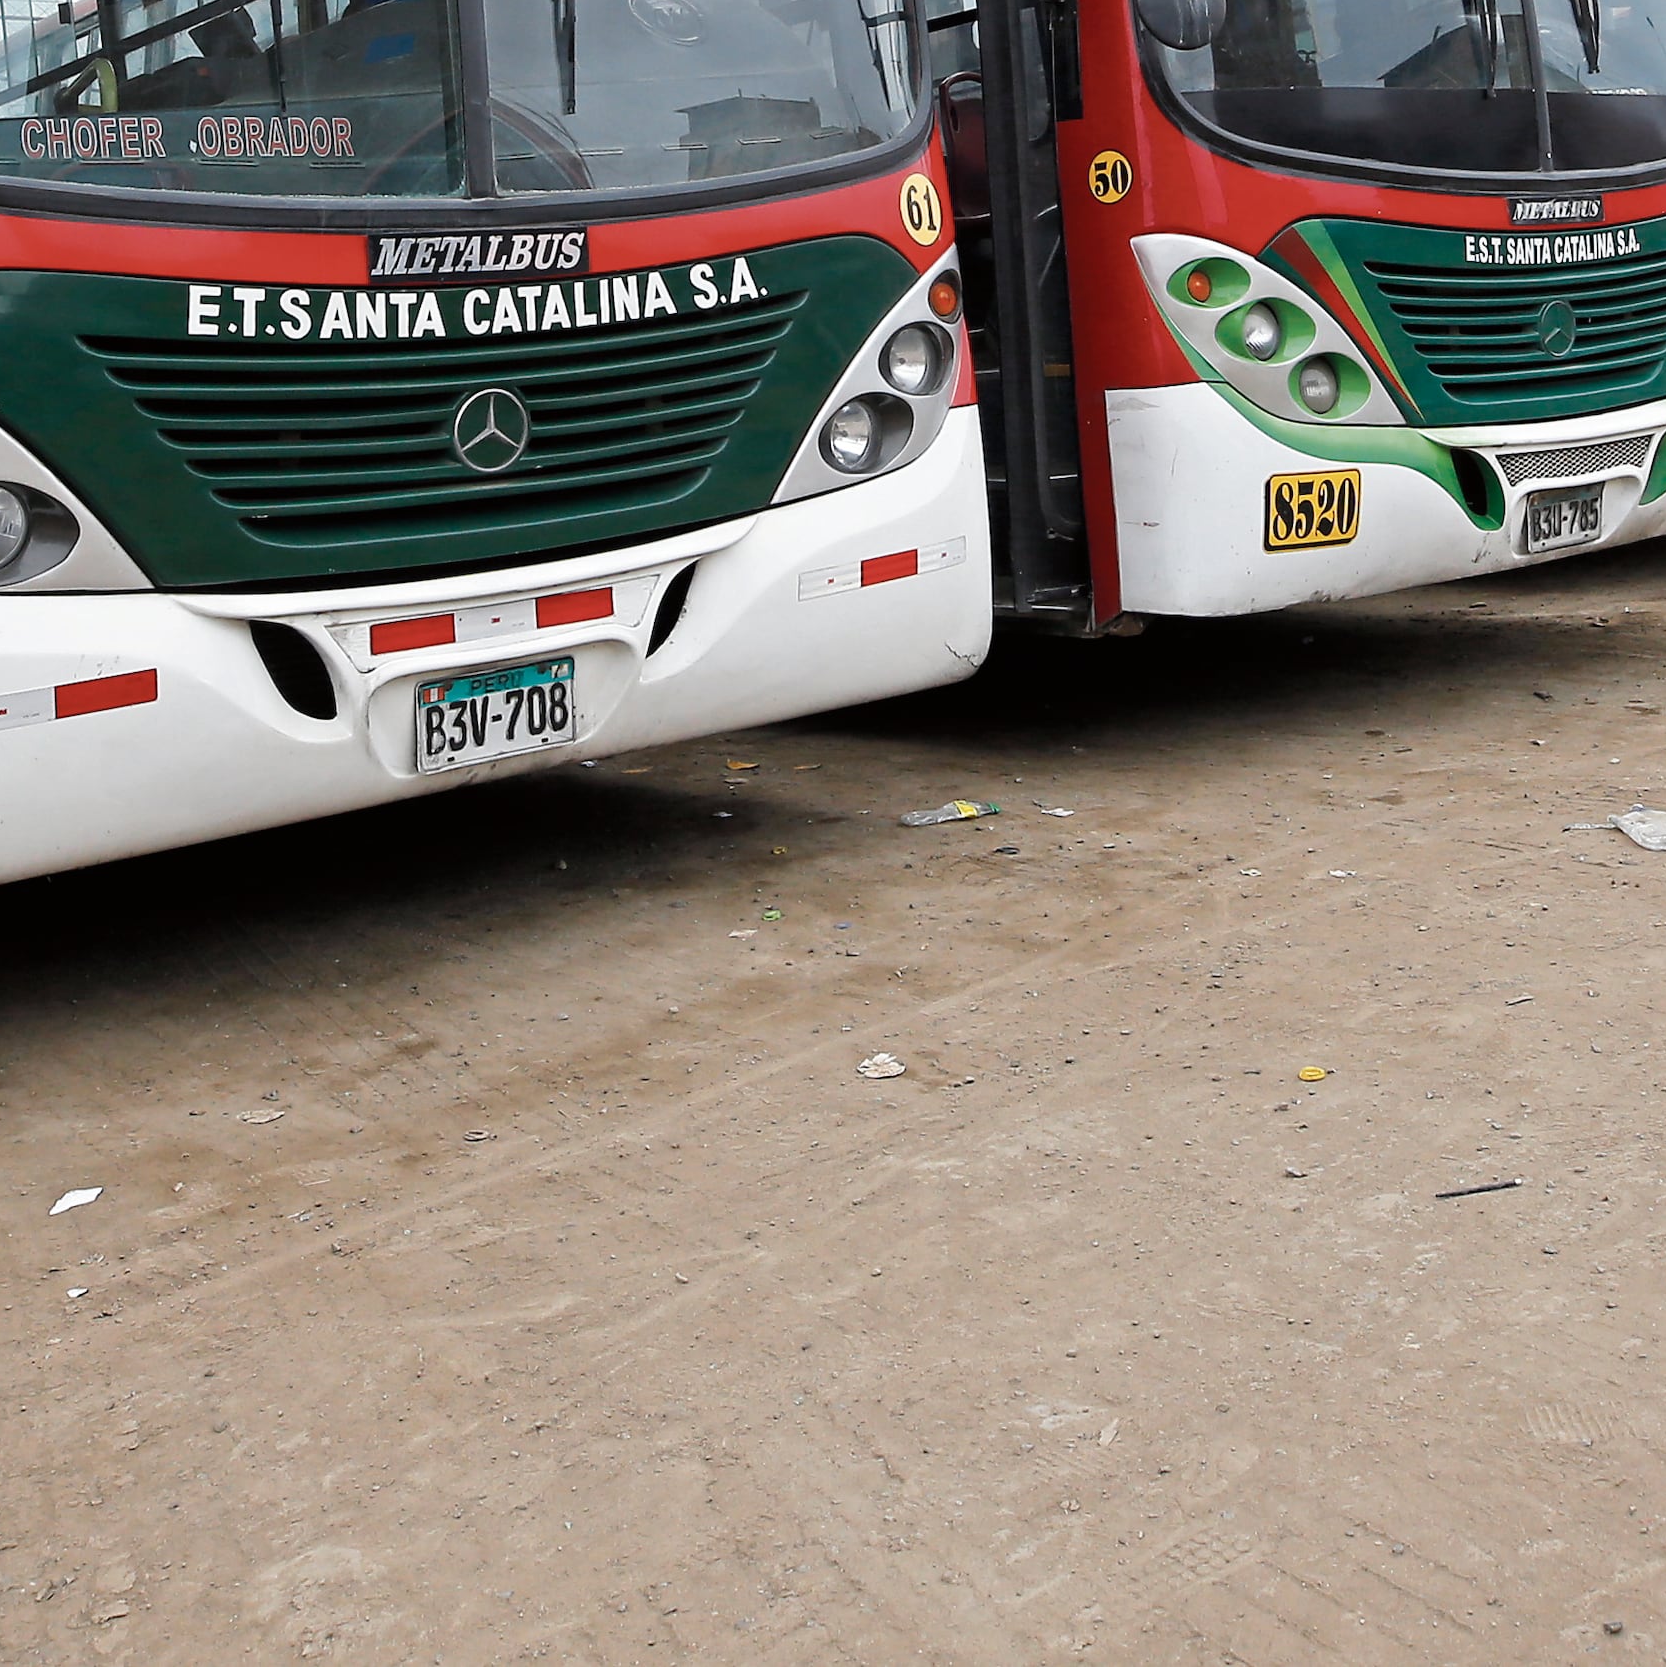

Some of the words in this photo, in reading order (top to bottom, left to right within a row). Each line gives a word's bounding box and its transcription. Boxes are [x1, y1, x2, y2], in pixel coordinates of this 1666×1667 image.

[21, 118, 166, 158] CHOFER
[190, 117, 356, 158] OBRADOR
[1091, 160, 1130, 198] 50
[907, 186, 938, 233] 61
[371, 232, 585, 276] METALBUS
[1465, 236, 1503, 264] E.S.T.
[1507, 237, 1552, 264] SANTA
[1554, 232, 1615, 263] CATALINA
[1617, 228, 1641, 256] S.A.
[463, 270, 678, 336] CATALINA
[691, 257, 768, 312] S.A.
[1273, 477, 1358, 544] 8520
[471, 672, 524, 695] PERU
[426, 683, 568, 756] B3V-708
